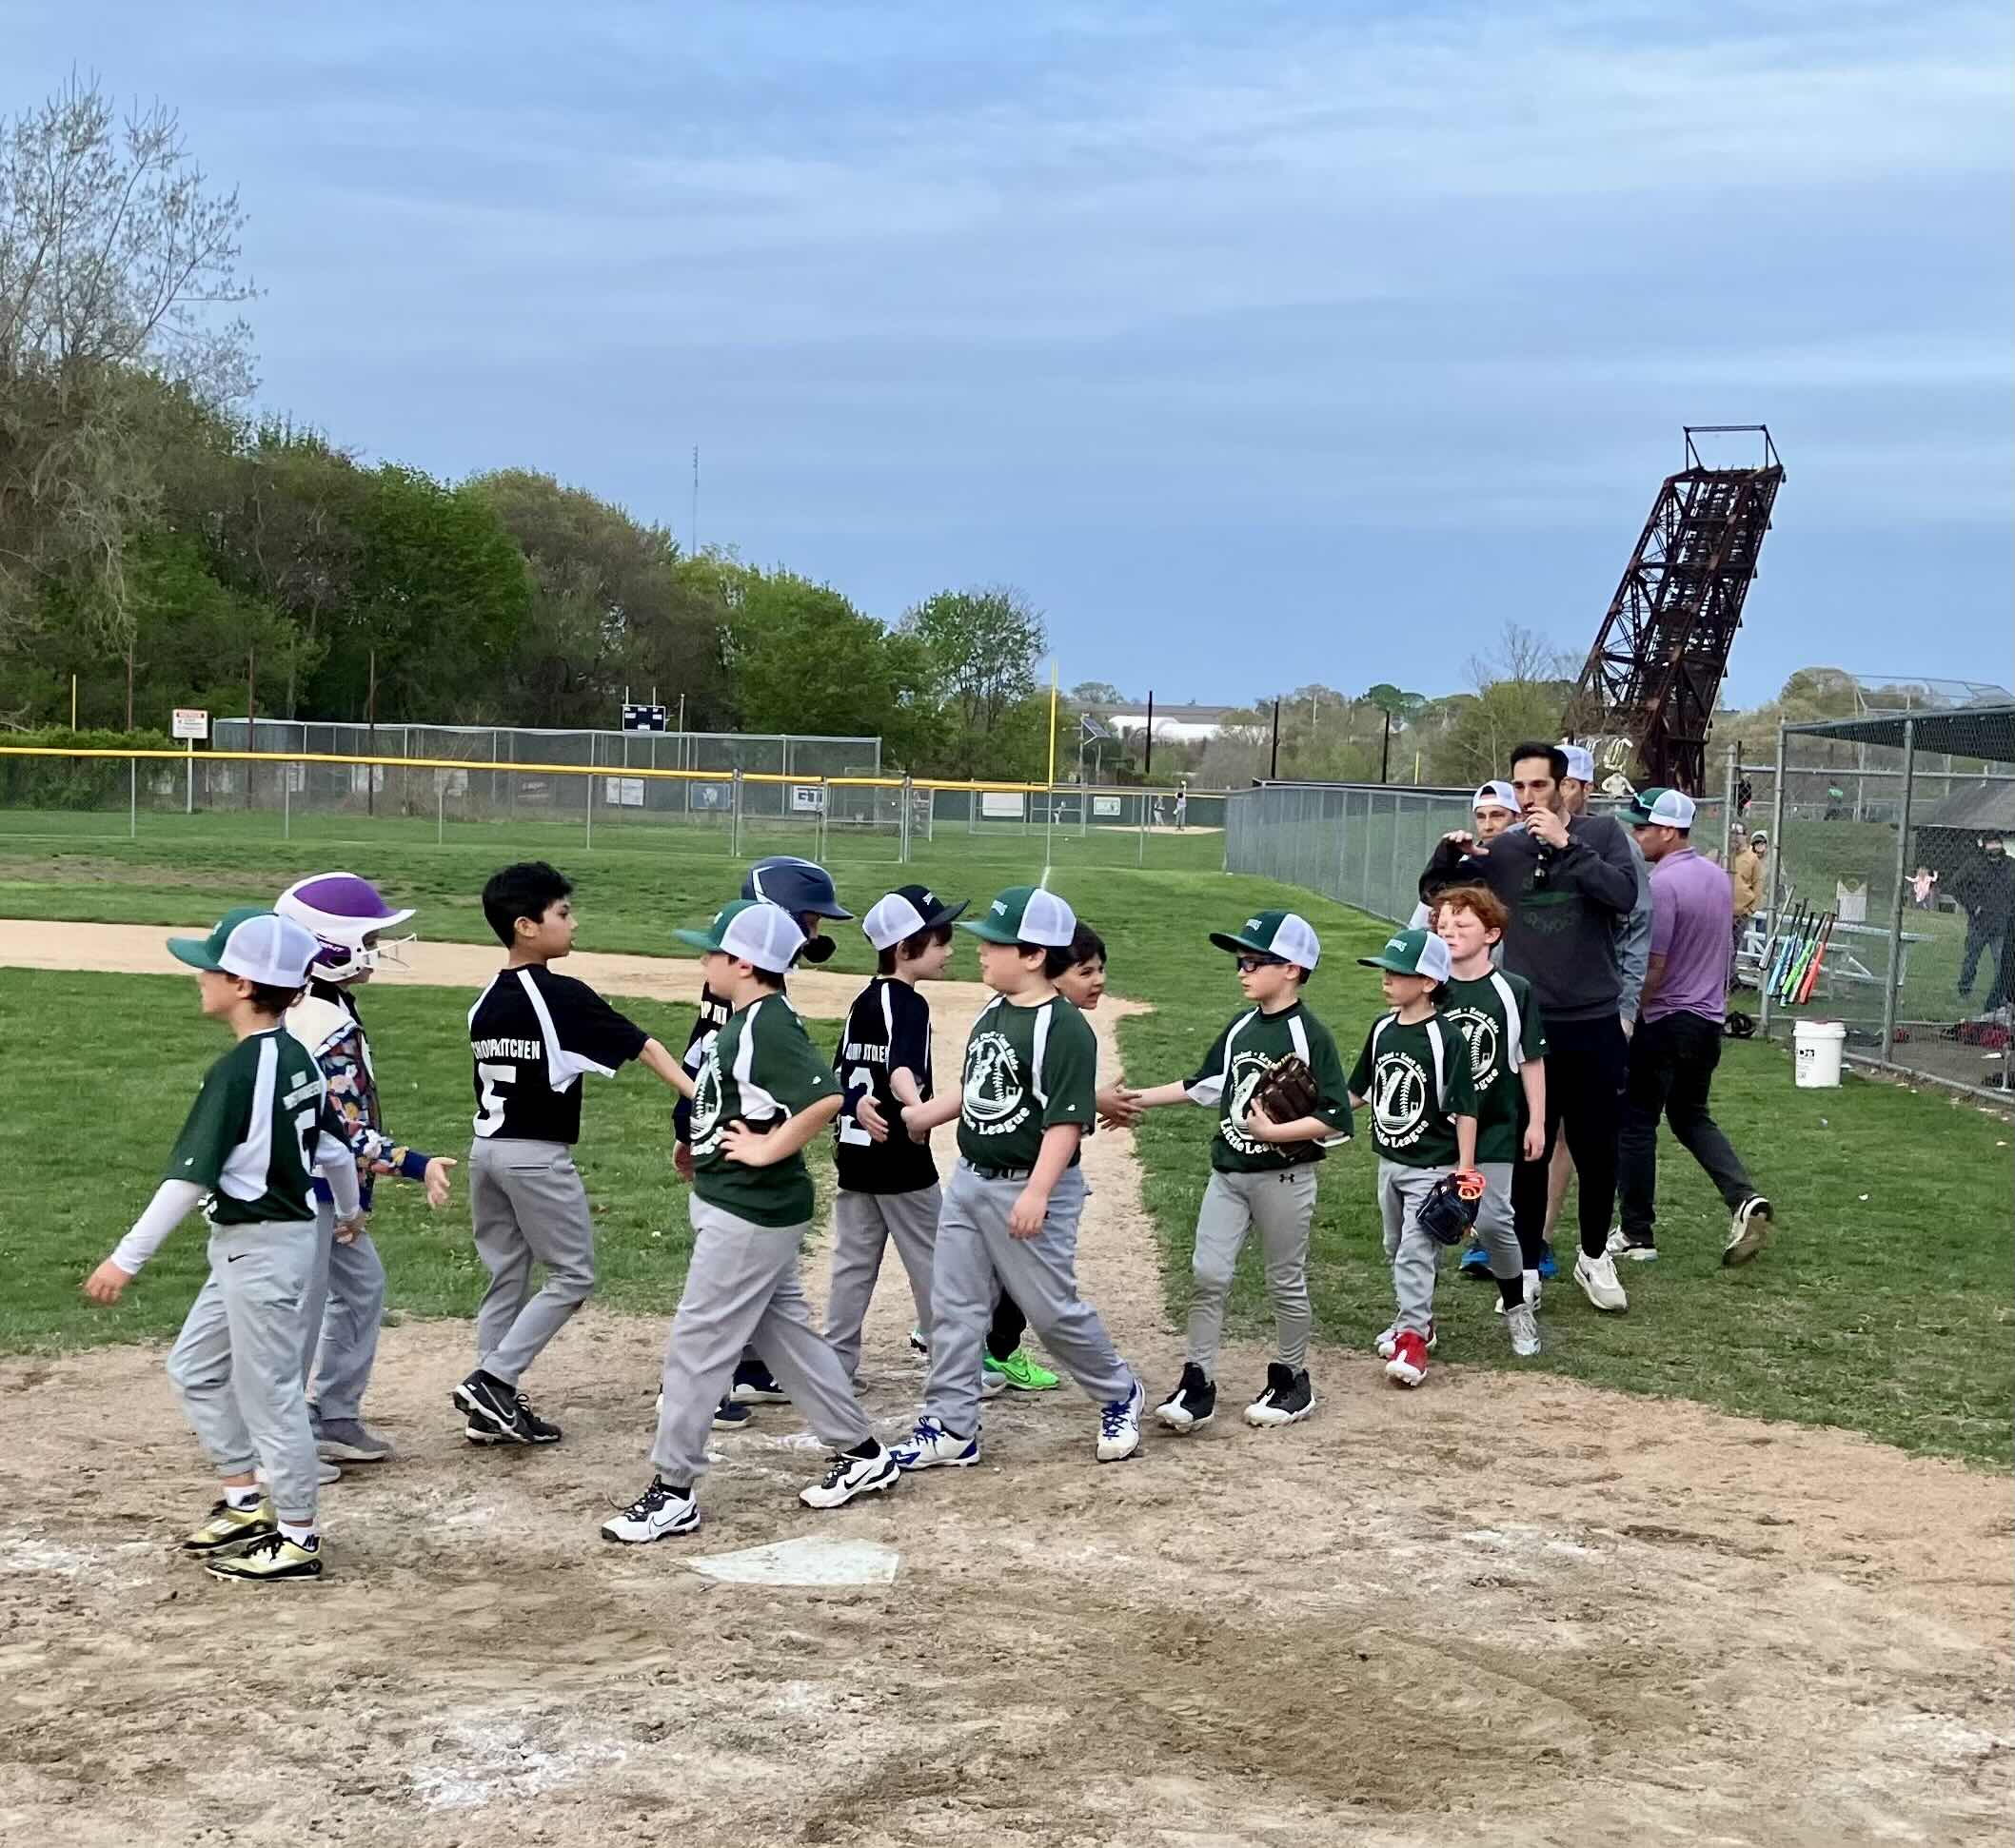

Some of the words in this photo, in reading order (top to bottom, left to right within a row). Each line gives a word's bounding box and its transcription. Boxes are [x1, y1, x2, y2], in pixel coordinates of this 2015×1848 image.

[472, 1061, 517, 1138] 5
[978, 1107, 1031, 1135] League
[1219, 1117, 1245, 1152] Little
[1391, 1119, 1430, 1149] League
